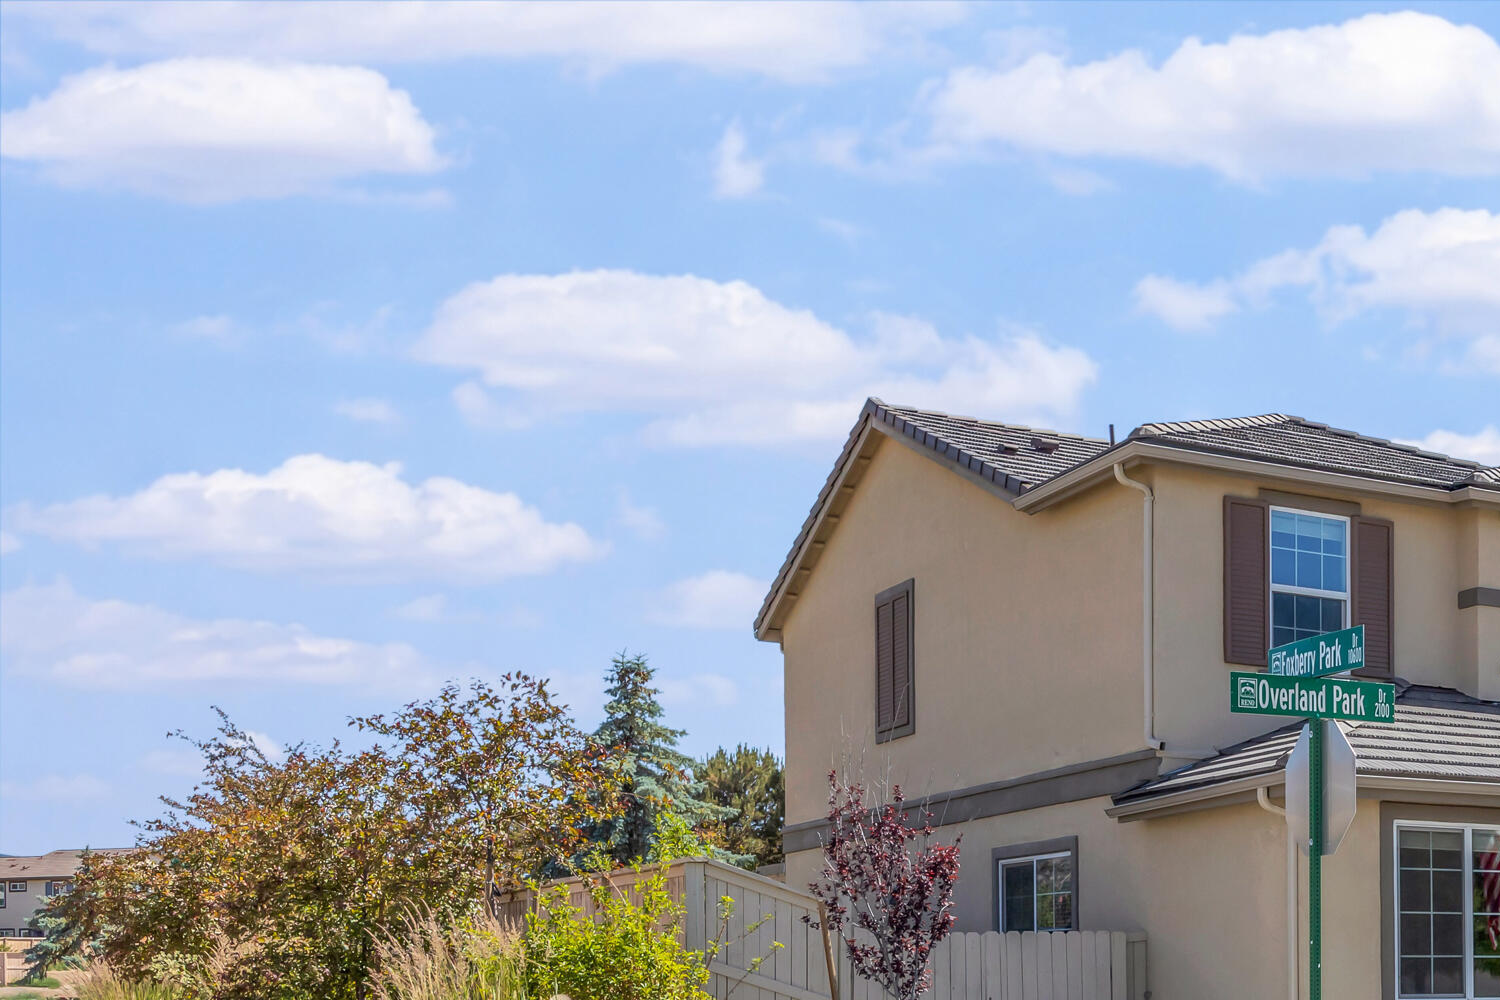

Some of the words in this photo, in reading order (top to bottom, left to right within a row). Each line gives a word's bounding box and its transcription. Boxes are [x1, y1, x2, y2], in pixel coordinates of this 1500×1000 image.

[1281, 647, 1316, 676] Foxberry
[1319, 637, 1342, 670] Park
[1352, 632, 1358, 649] Dr
[1259, 679, 1327, 713] Overland
[1333, 685, 1366, 716] Park
[1378, 688, 1387, 704] Dr
[1374, 702, 1390, 719] 2100
